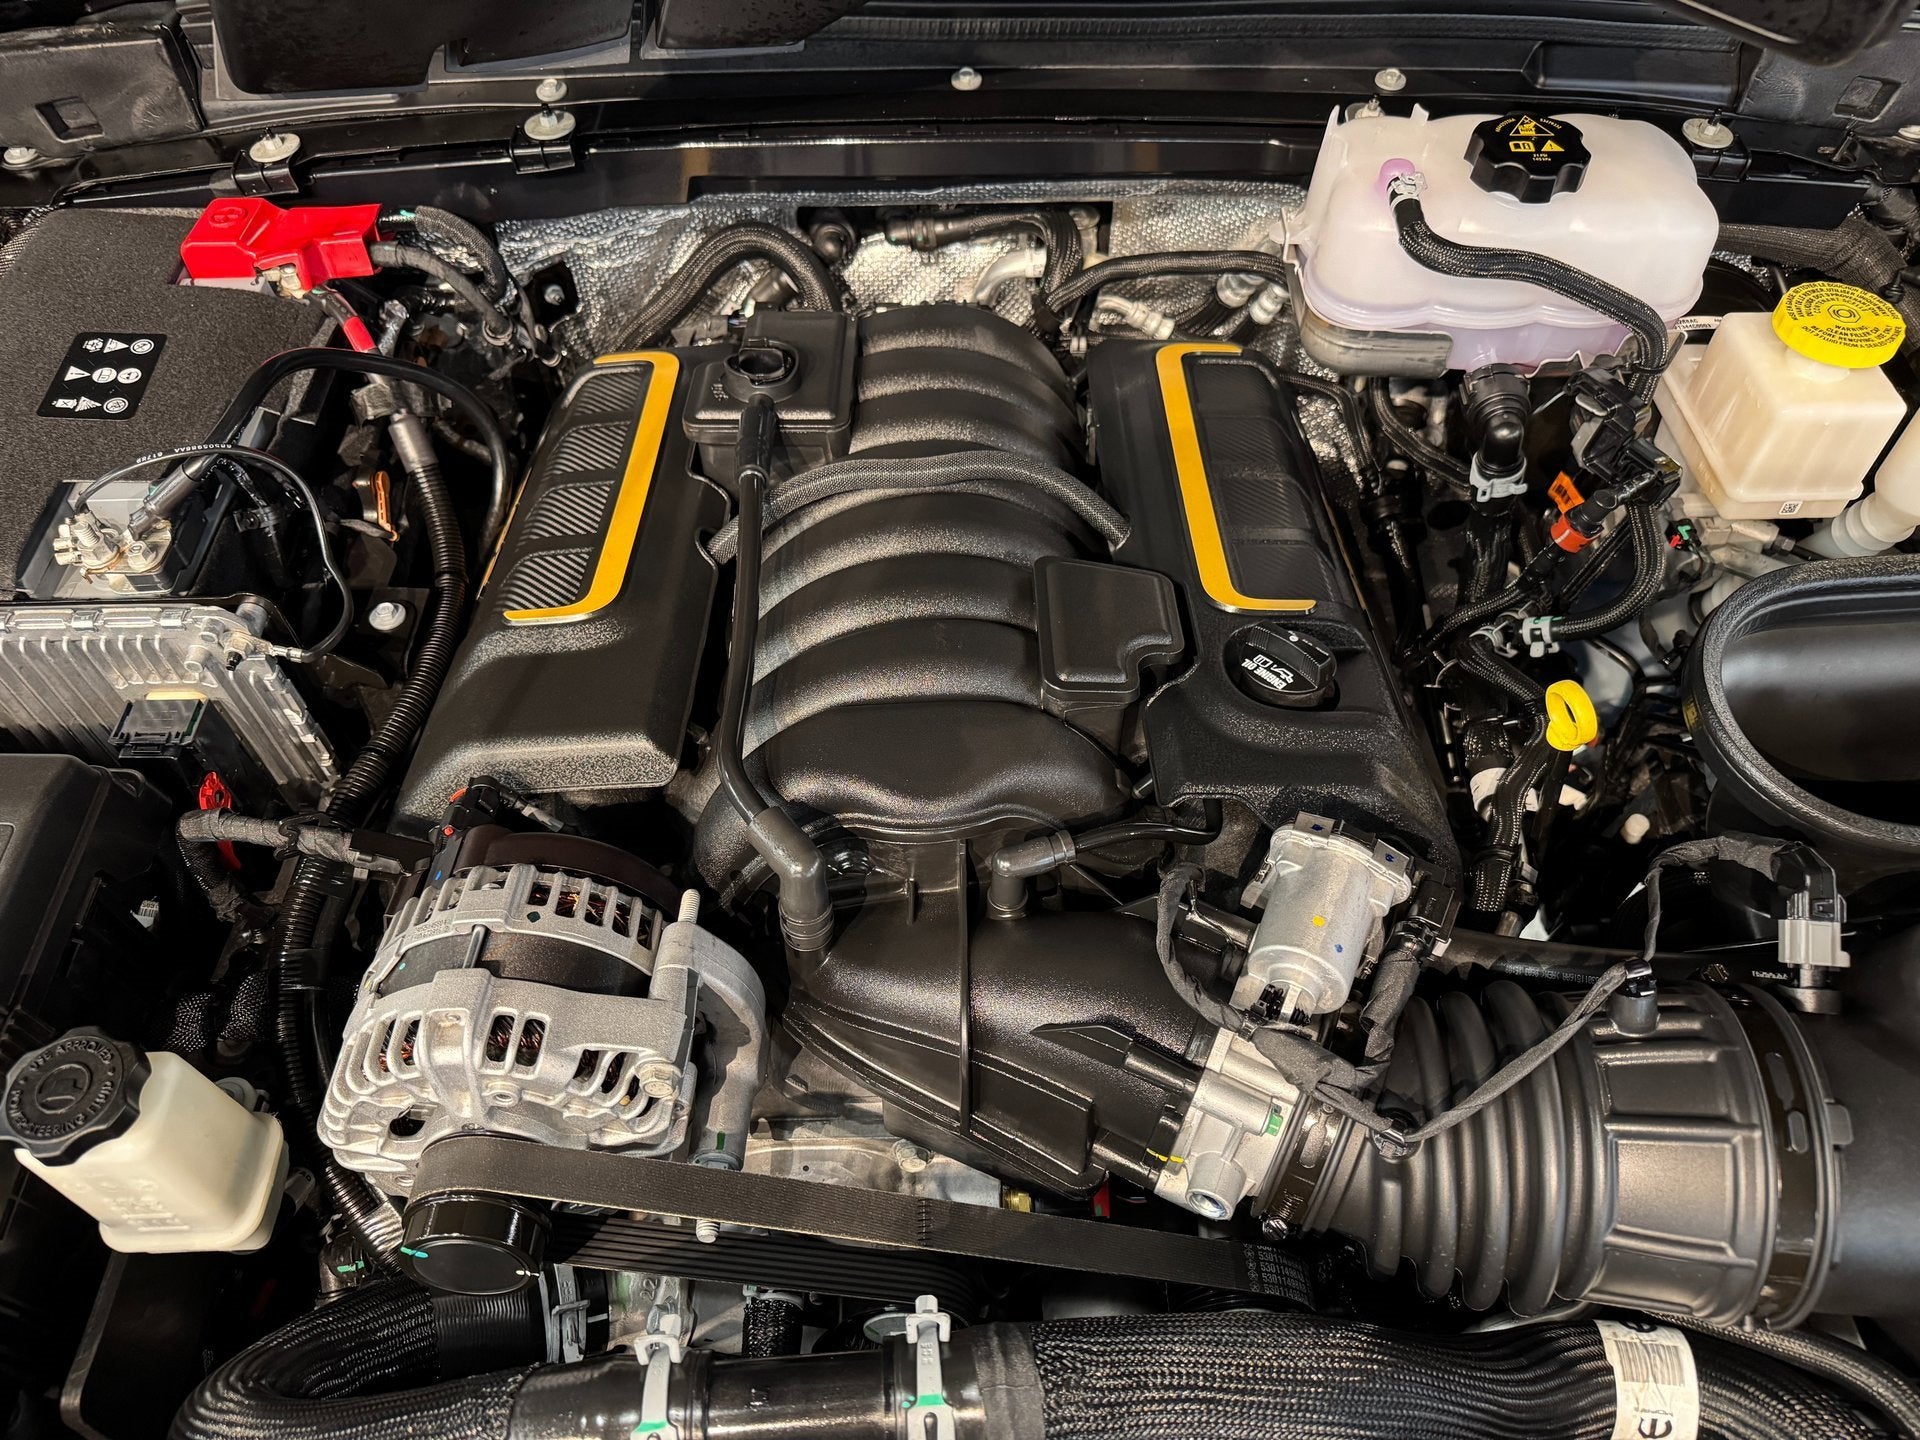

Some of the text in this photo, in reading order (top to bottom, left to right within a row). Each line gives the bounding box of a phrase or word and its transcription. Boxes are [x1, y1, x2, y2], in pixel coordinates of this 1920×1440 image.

[1809, 324, 1835, 339] BEFORE
[1825, 326, 1848, 337] CLEAN
[1241, 658, 1288, 690] ENGINE OIL
[29, 1040, 115, 1072] USE APPROVED
[24, 1113, 87, 1137] STEERING
[86, 1081, 114, 1115] FLUID
